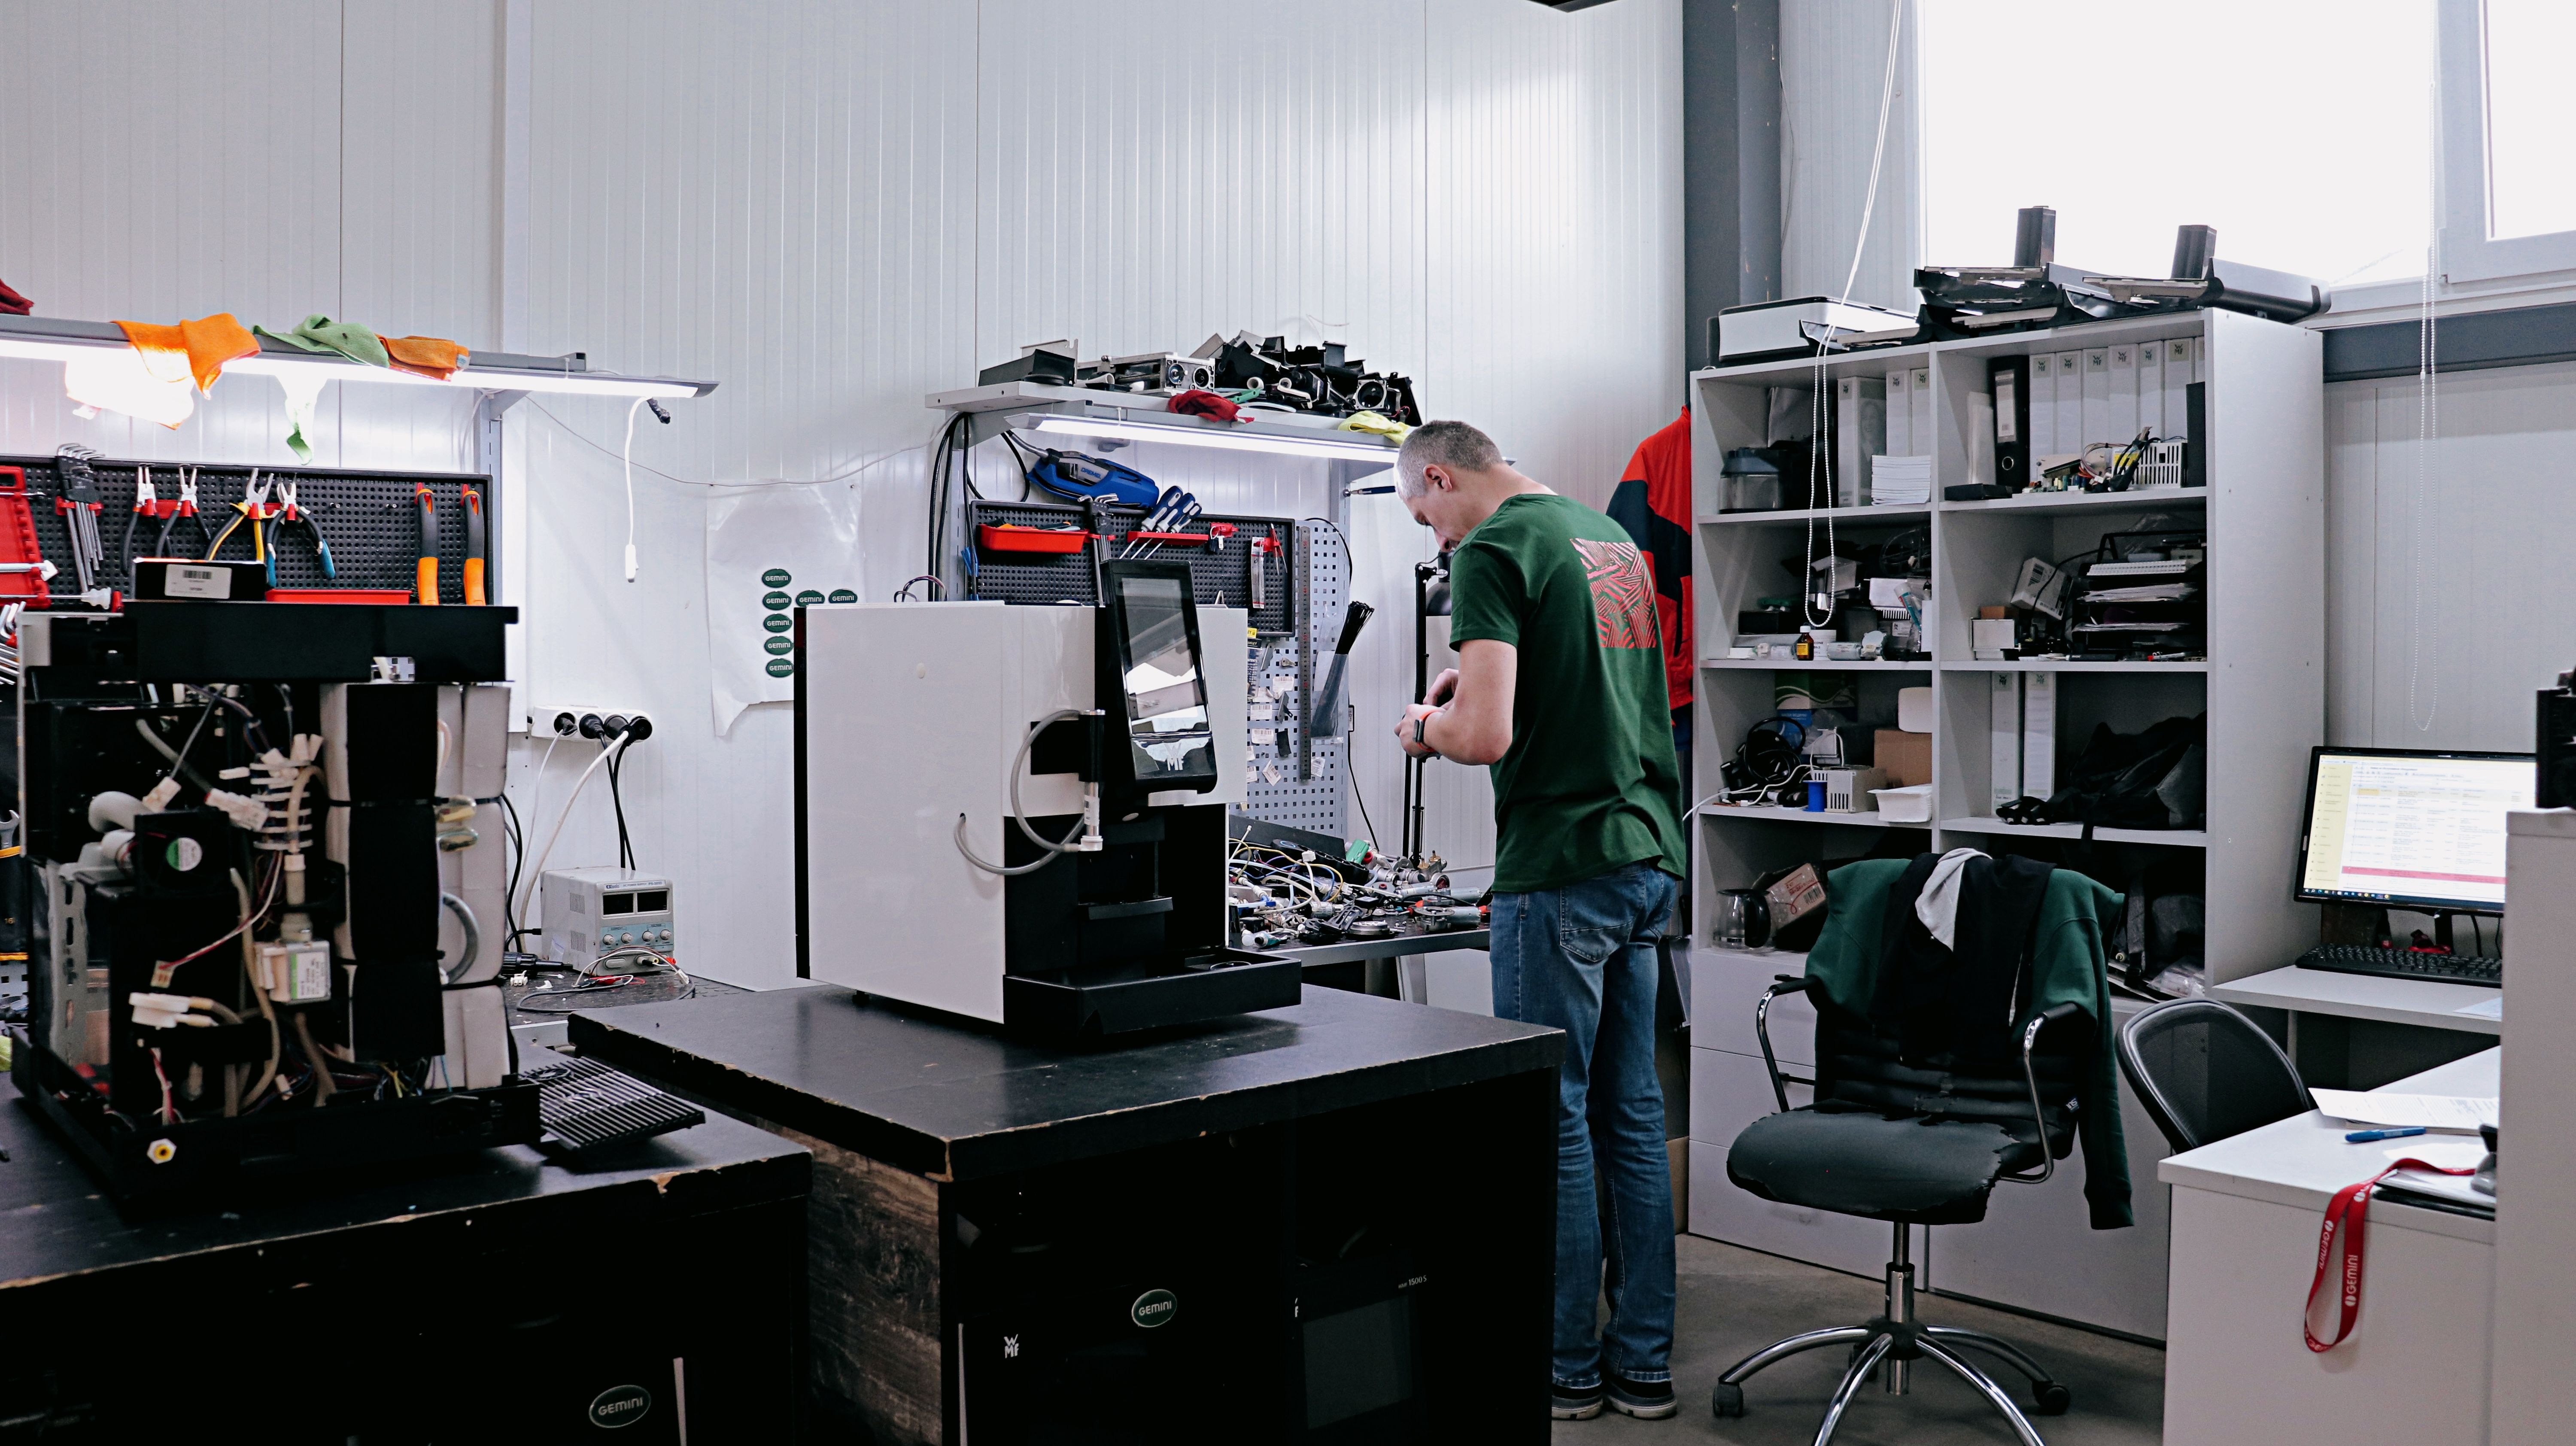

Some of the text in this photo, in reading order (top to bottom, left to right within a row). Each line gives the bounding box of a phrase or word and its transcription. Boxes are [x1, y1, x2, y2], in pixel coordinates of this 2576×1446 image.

[1081, 467, 1101, 479] DREMEL
[2319, 1231, 2330, 1269] GEMINI
[1408, 1276, 1423, 1286] 1500
[2345, 1255, 2358, 1295] GEMINI
[1139, 1300, 1172, 1316] GEMINI
[598, 1397, 643, 1416] GEMINI
